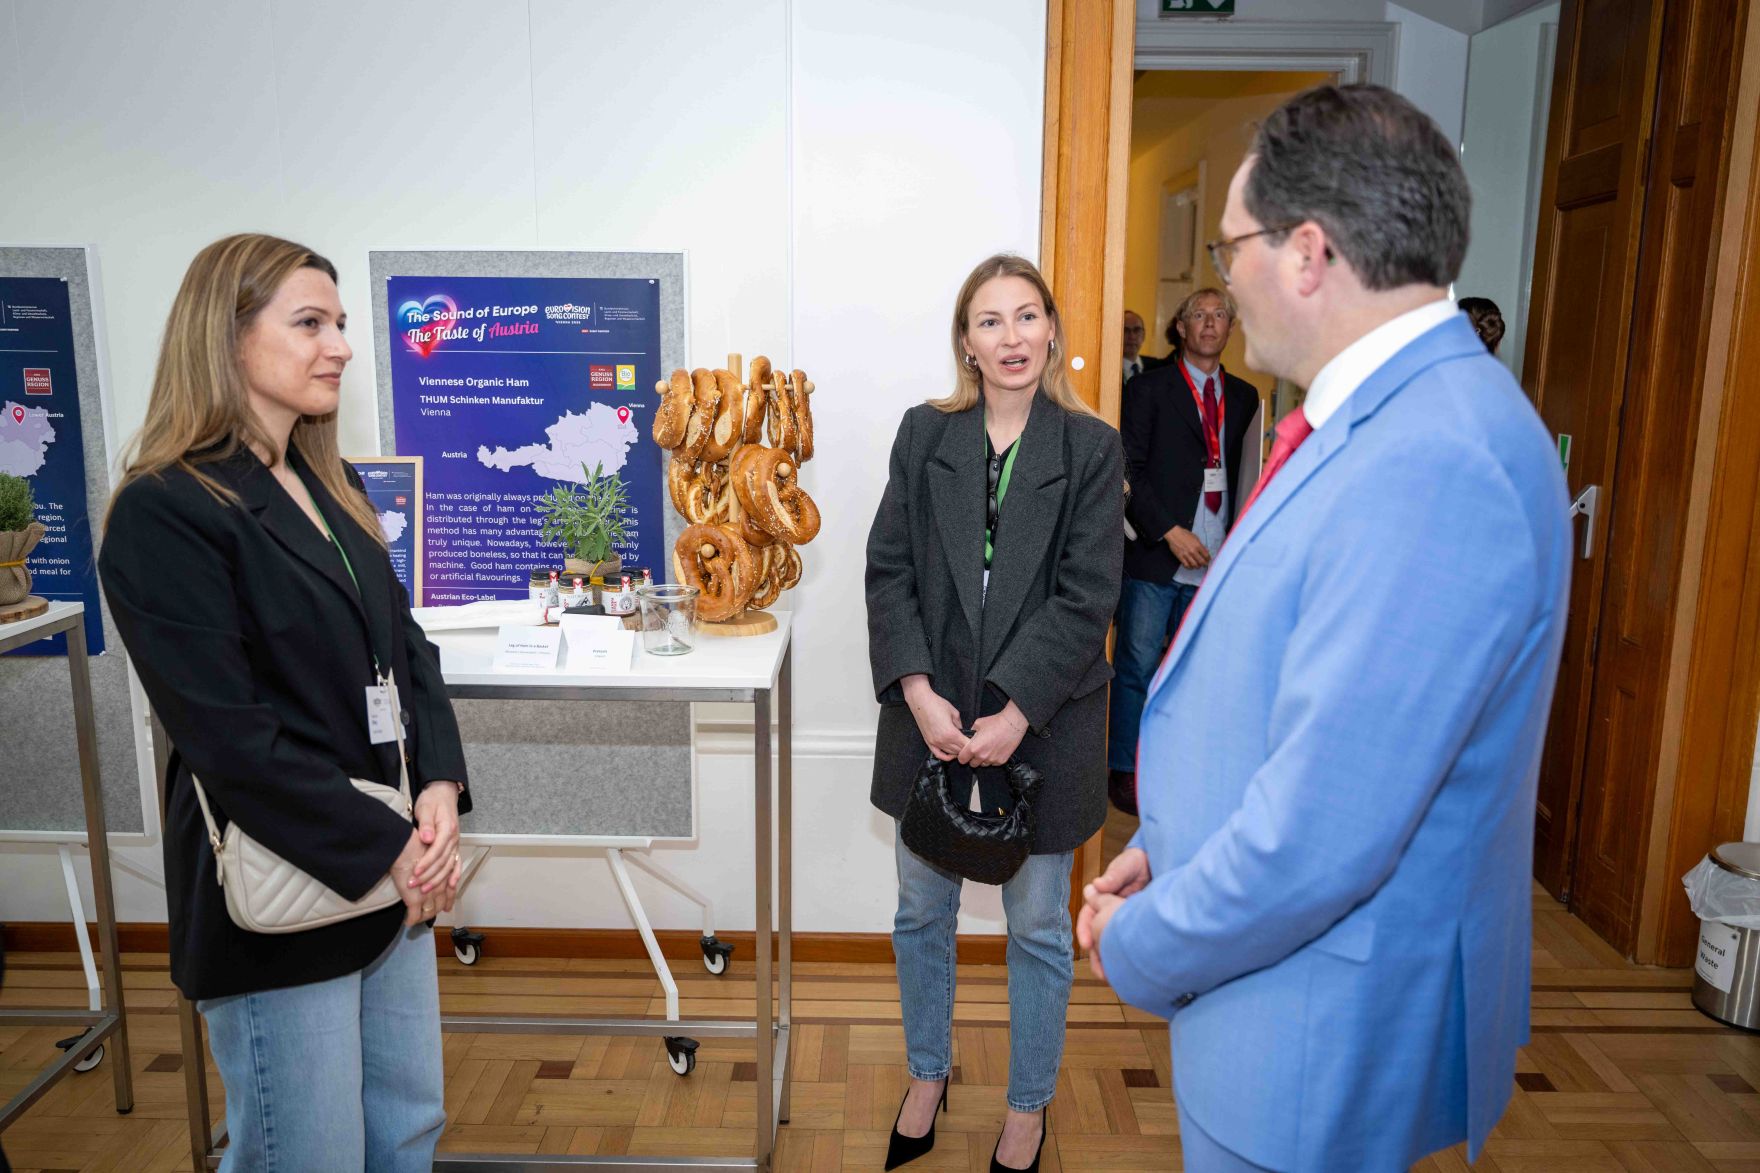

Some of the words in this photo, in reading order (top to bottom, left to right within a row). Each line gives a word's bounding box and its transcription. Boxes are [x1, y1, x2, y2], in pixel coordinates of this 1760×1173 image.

[407, 312, 430, 322] The
[433, 308, 473, 320] Sound
[476, 306, 489, 318] of
[493, 305, 538, 316] Europe
[408, 328, 431, 343] The
[433, 326, 469, 340] Taste
[472, 323, 487, 342] of
[489, 321, 539, 339] Austria
[419, 377, 464, 386] Viennese
[466, 377, 504, 388] Organic
[506, 378, 529, 386] Ham
[420, 396, 448, 404] THUM
[450, 396, 490, 404] Schinken
[492, 396, 544, 405] Manufaktur
[420, 408, 451, 416] Vienna
[464, 493, 501, 502] originally
[503, 493, 531, 502] always
[38, 514, 64, 522] region,
[476, 516, 508, 525] through
[480, 529, 502, 537] many
[428, 539, 447, 547] truly
[487, 540, 531, 548] Nowadays,
[428, 550, 468, 559] produced
[470, 551, 509, 559] boneless,
[629, 553, 639, 561] by
[476, 573, 522, 583] flavourings.
[1702, 935, 1726, 957] General
[1700, 950, 1719, 969] Waste
